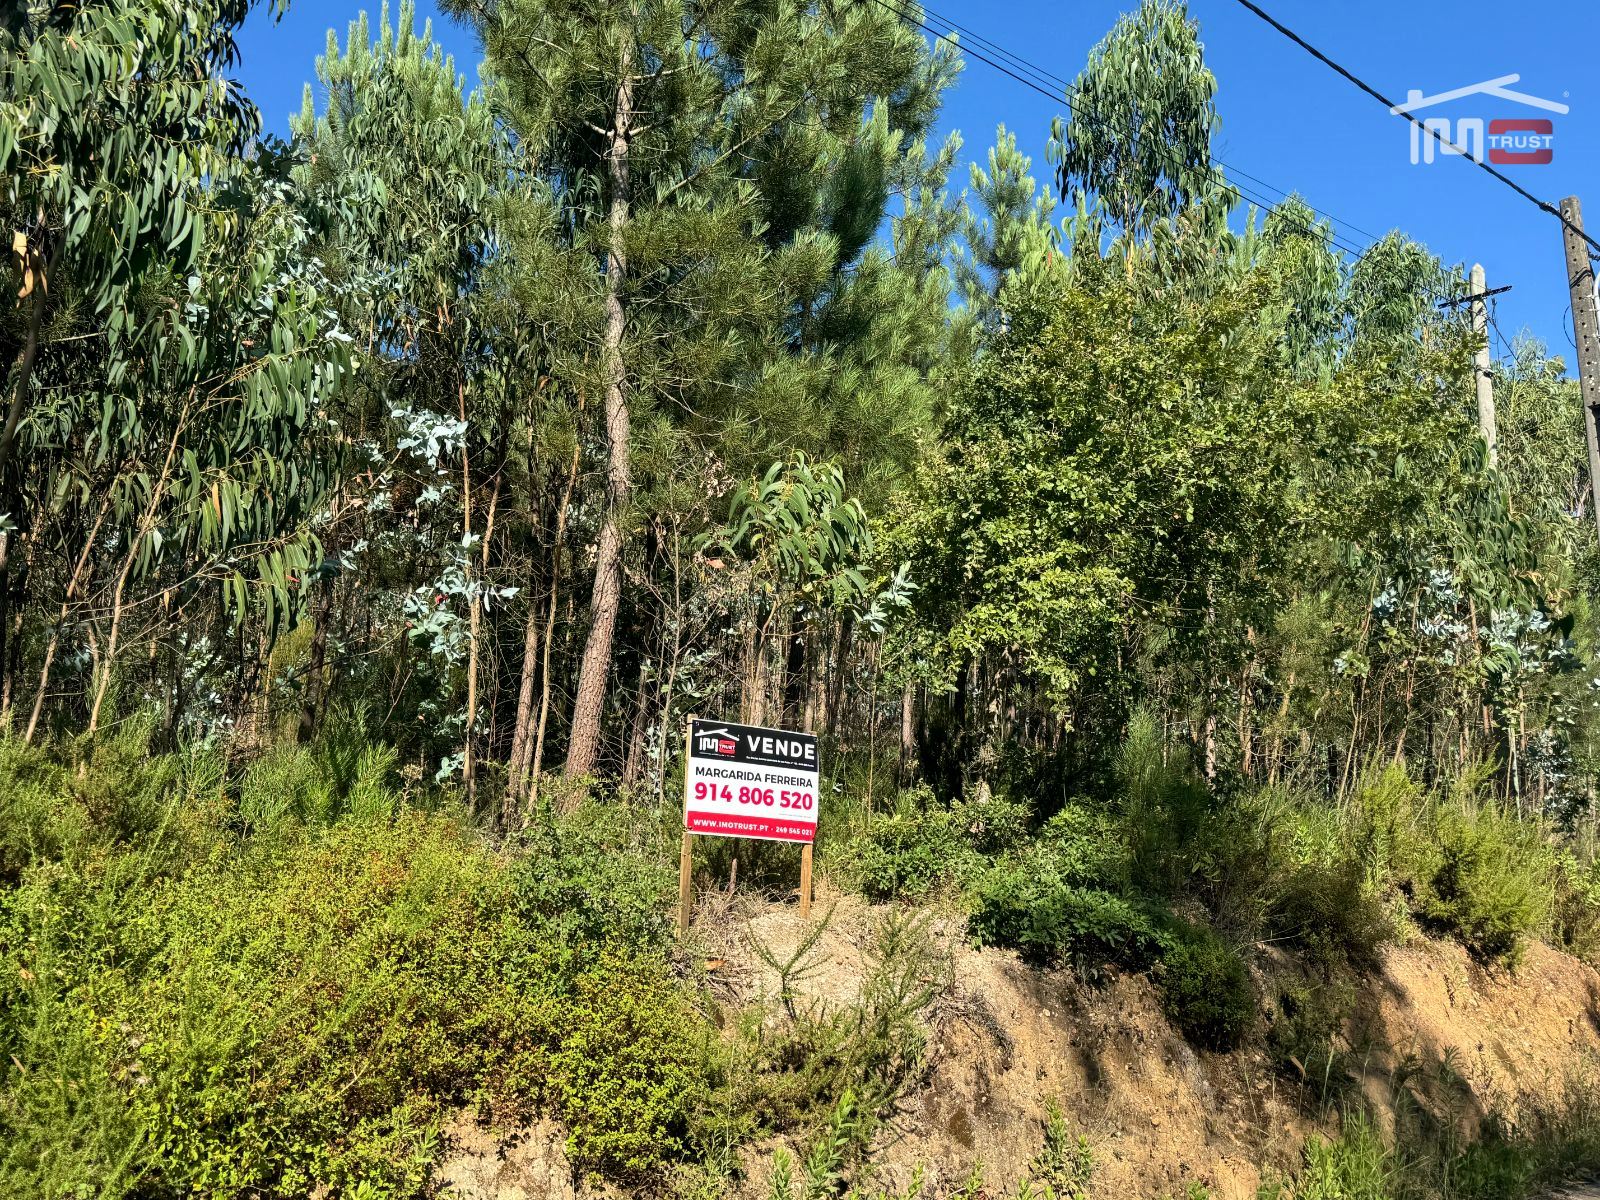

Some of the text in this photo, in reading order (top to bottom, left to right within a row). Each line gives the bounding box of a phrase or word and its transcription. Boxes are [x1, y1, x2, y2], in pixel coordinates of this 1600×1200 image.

[747, 735, 815, 760] VENDE
[695, 766, 813, 788] MARGARIDA FERREIRA
[695, 782, 813, 811] 914 806 520
[693, 819, 769, 832] WWW.IMOTRUST.PT
